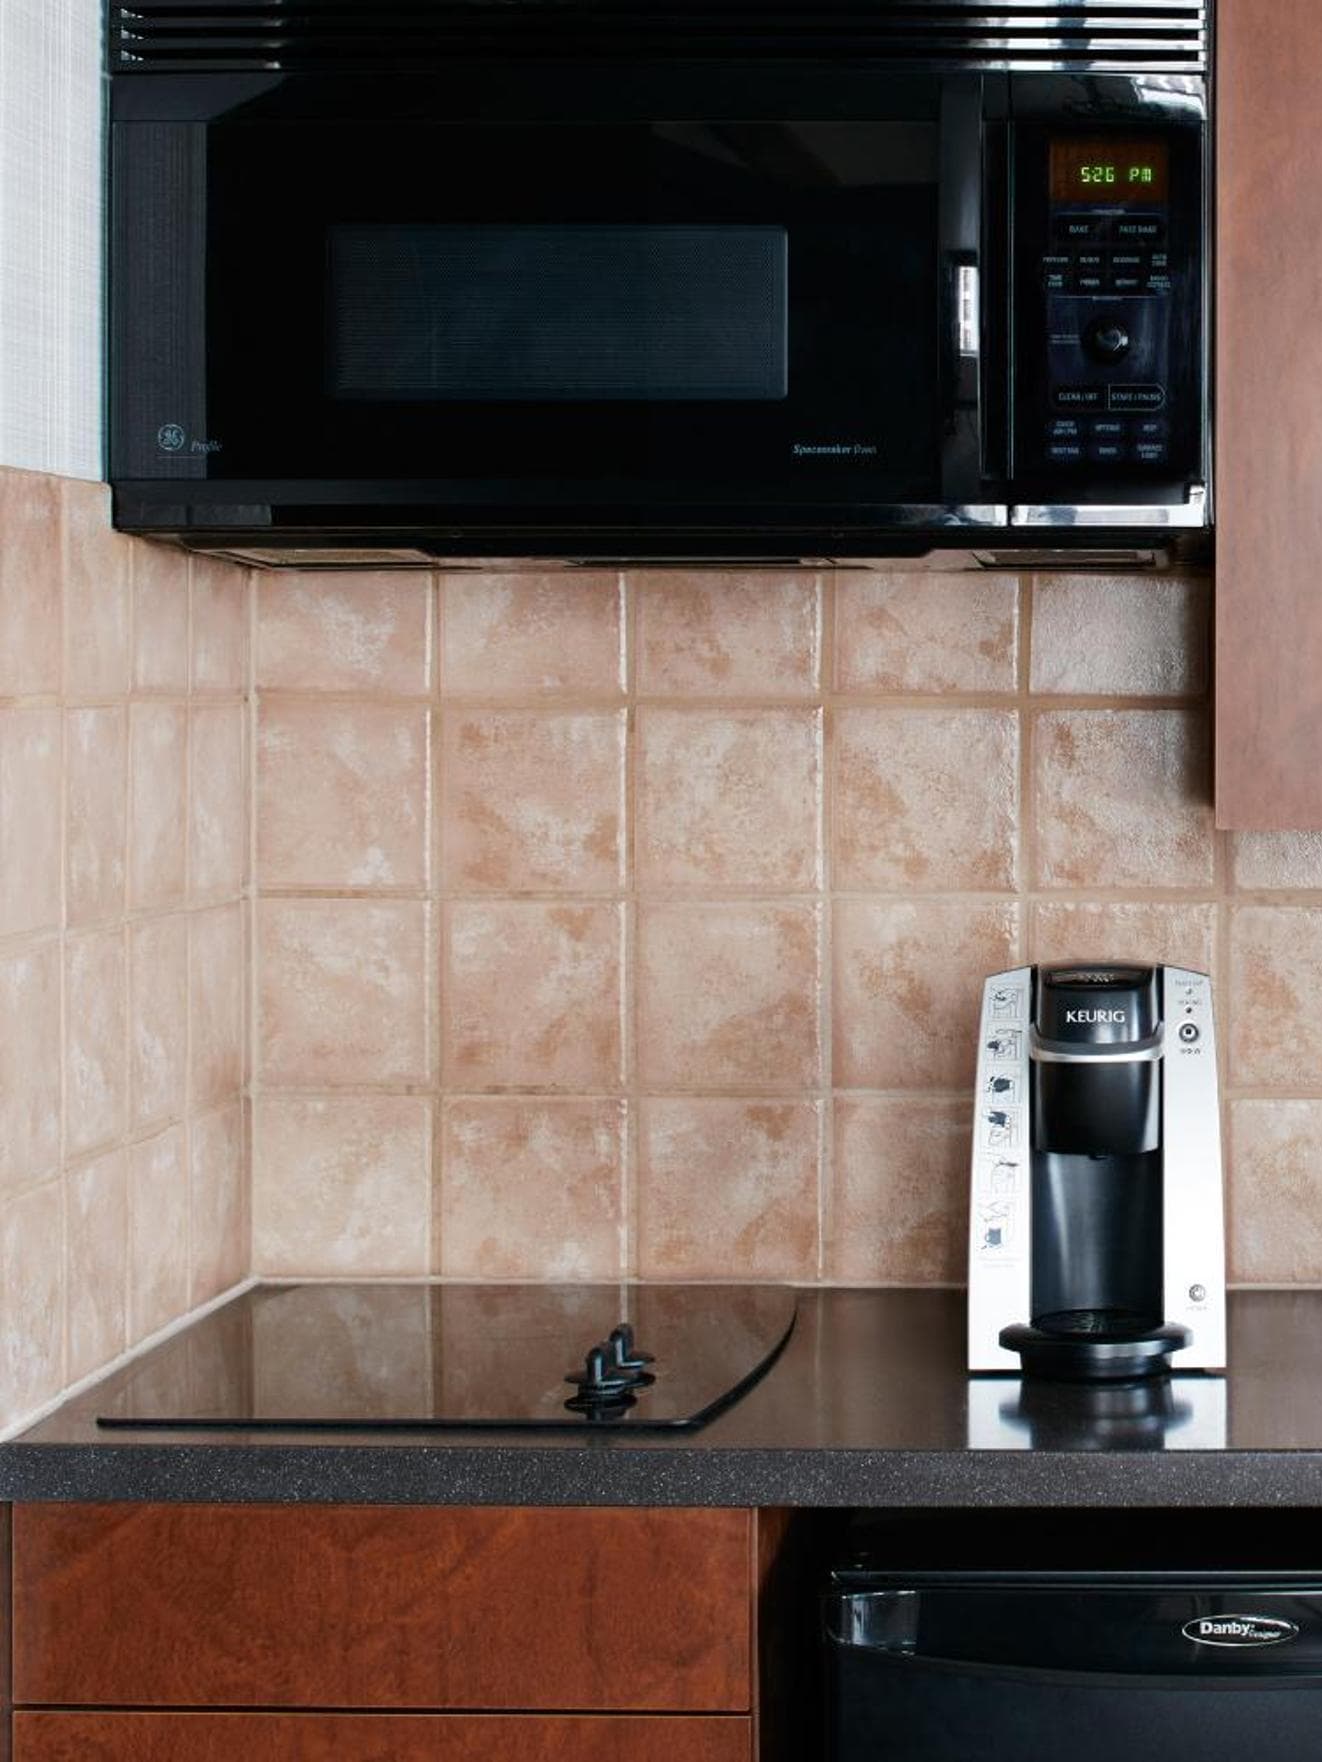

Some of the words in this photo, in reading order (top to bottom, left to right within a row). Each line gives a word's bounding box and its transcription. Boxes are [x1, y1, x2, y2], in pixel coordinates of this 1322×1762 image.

[1128, 166, 1152, 183] PM
[1065, 1009, 1126, 1023] KEURIG
[1199, 1621, 1251, 1637] Danby
